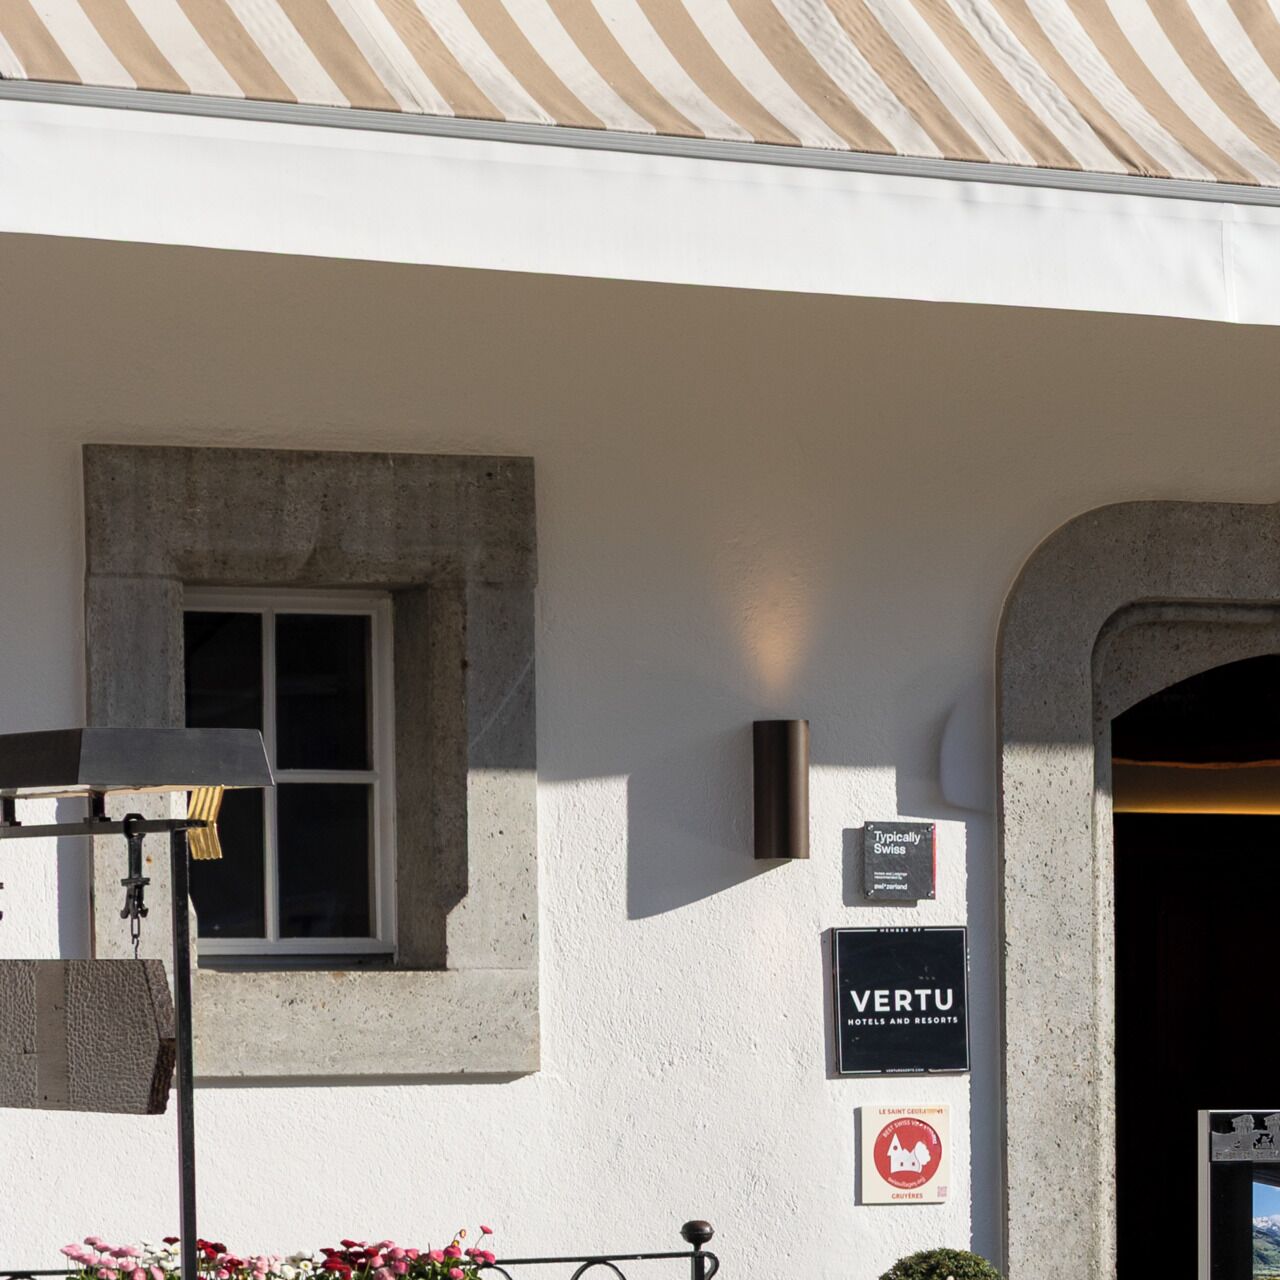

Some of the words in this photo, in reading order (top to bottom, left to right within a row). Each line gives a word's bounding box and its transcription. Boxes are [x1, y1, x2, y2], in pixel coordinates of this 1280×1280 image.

[874, 831, 920, 845] Typically
[874, 843, 906, 854] Swiss
[850, 988, 953, 1012] VERTU
[847, 1018, 885, 1026] HOTELS
[889, 1017, 910, 1025] AND
[914, 1016, 959, 1024] RESORTS
